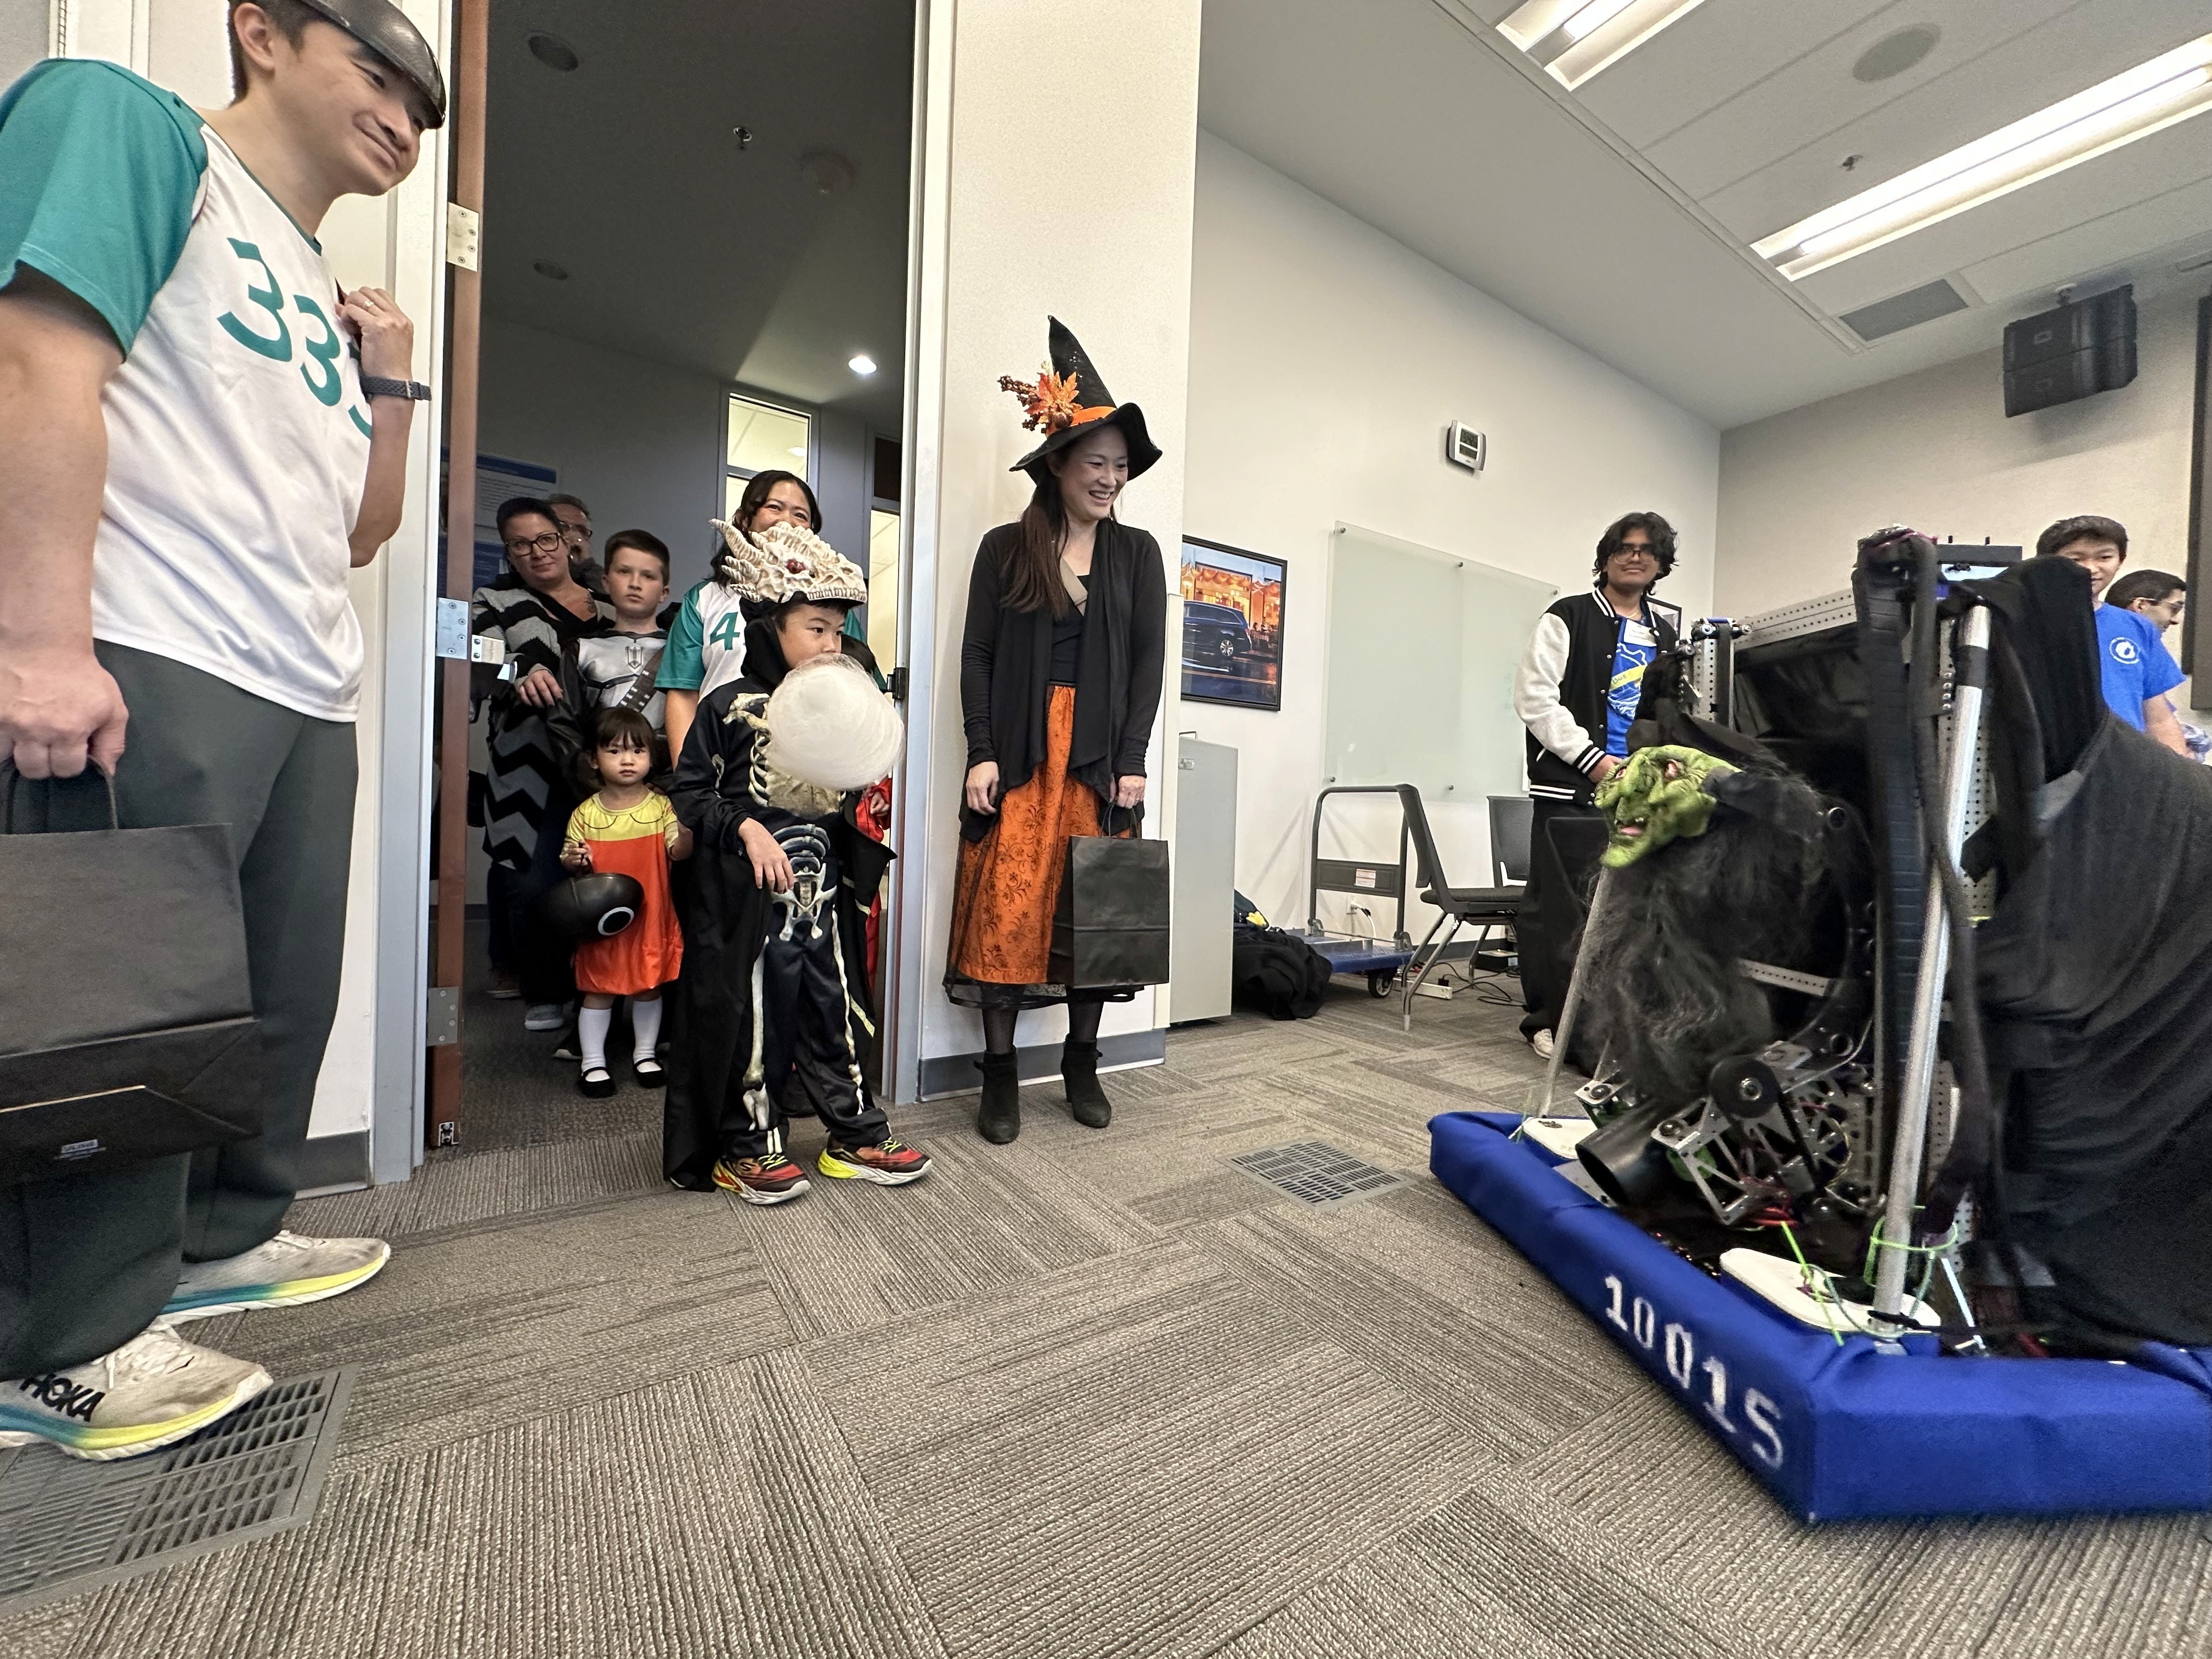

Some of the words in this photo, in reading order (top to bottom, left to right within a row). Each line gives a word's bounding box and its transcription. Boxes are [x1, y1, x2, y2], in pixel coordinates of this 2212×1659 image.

[217, 237, 373, 441] 33
[709, 611, 746, 651] 4
[19, 1373, 106, 1422] HOKA
[1605, 1273, 1782, 1469] 10015
